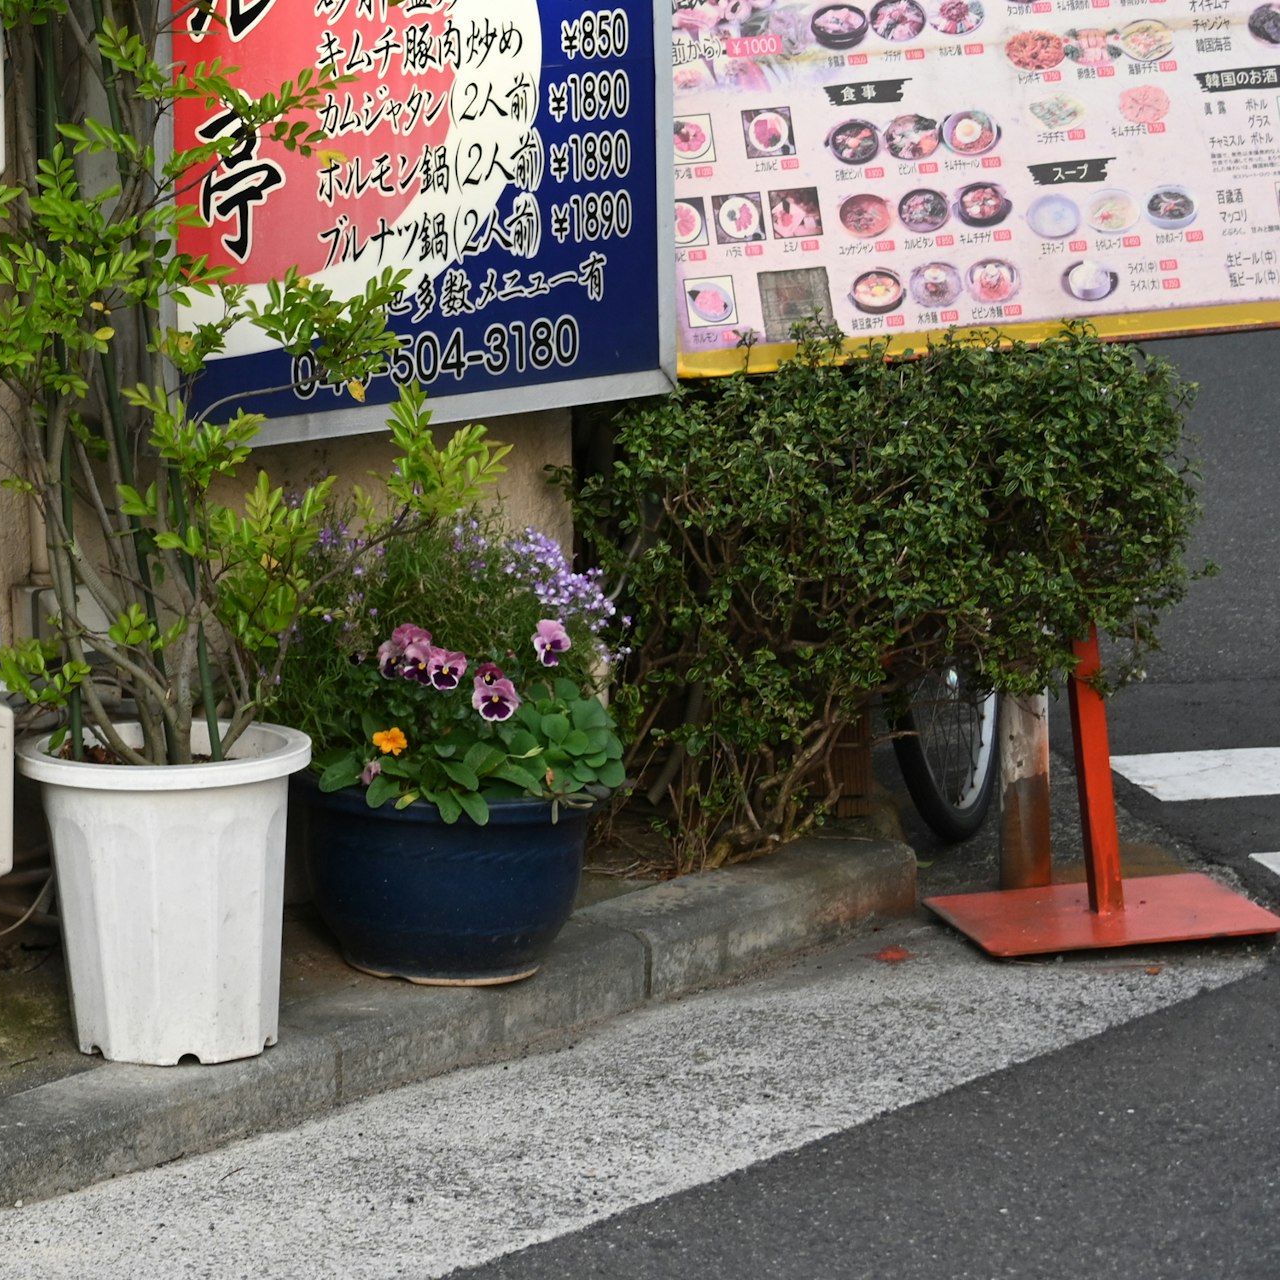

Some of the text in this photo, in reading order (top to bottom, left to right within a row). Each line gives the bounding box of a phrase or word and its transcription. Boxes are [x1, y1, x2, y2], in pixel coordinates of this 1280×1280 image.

[560, 7, 629, 60] ¥850
[732, 37, 777, 55] ¥1000
[548, 68, 631, 122] ¥1890
[842, 83, 876, 102] 食事
[1205, 68, 1278, 89] 韓国のお酒
[316, 128, 632, 206] ホルモン鍋(2人前) ¥1890
[1052, 164, 1089, 181] スープ
[550, 188, 633, 243] ¥1890
[1226, 250, 1277, 267] 生ビール(中)
[292, 314, 580, 401] 0-504-3180
